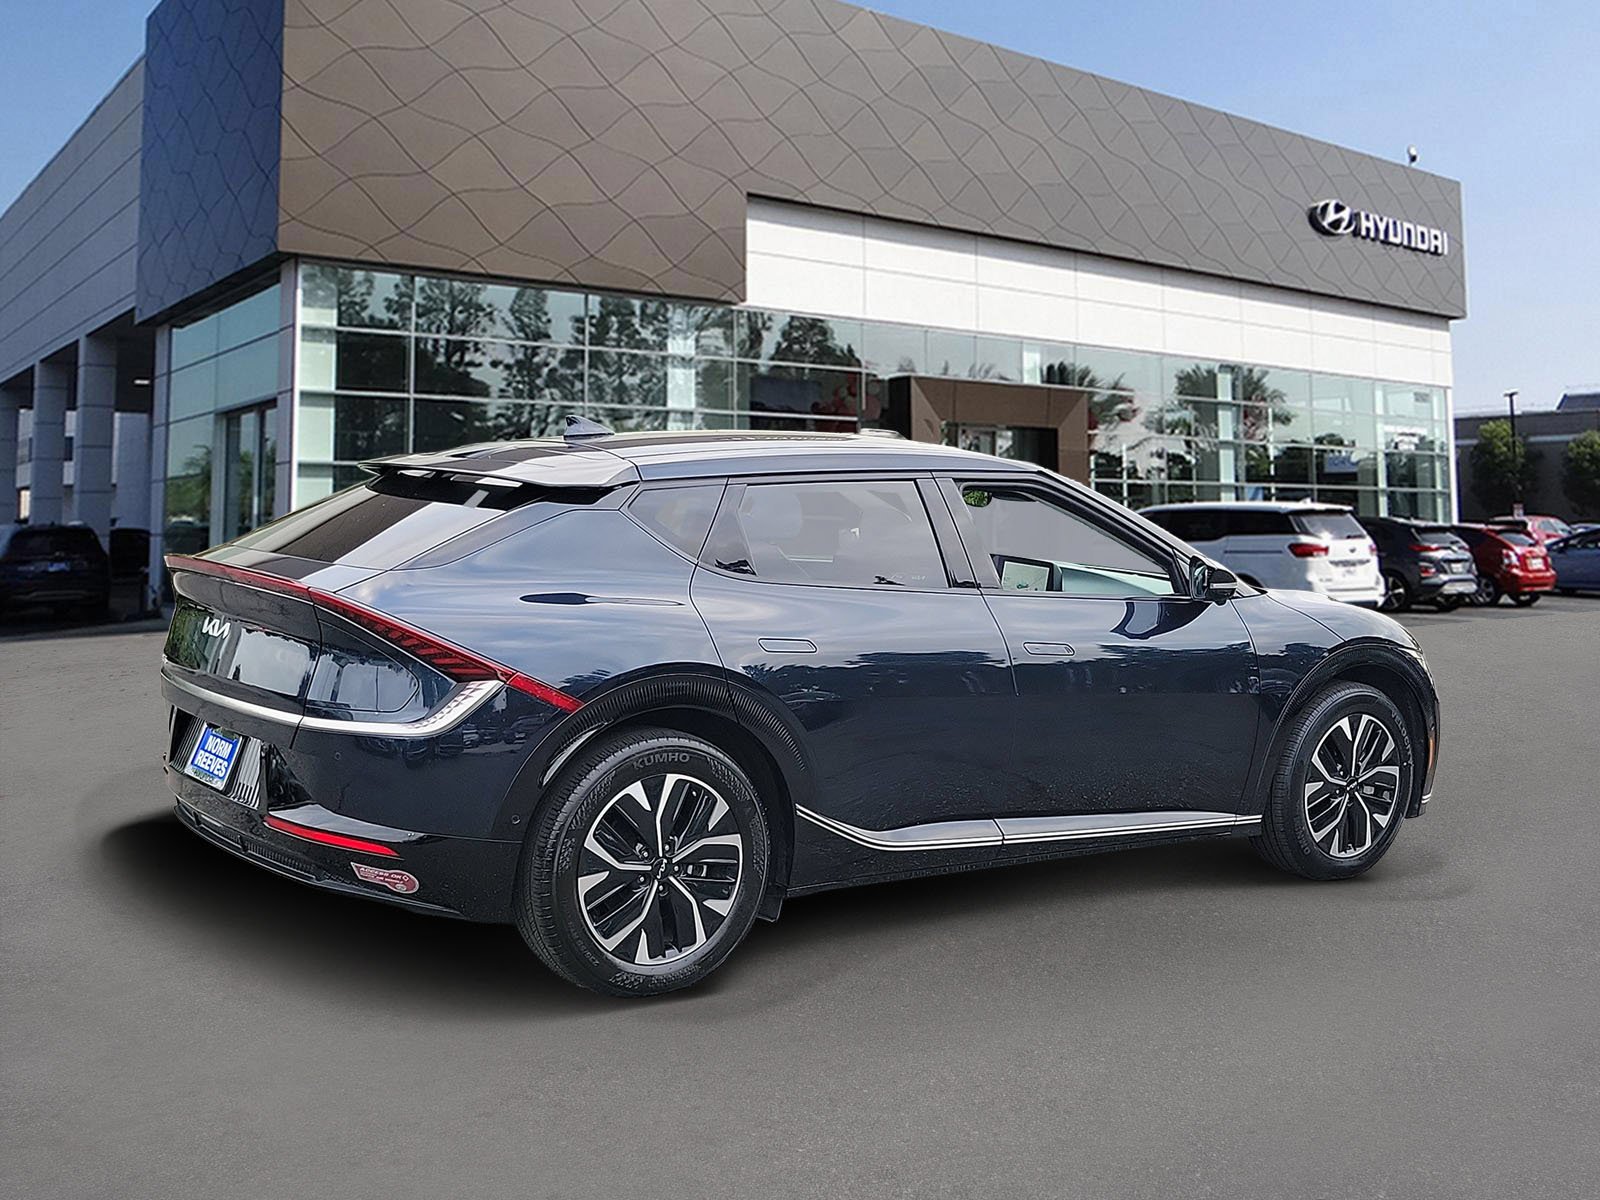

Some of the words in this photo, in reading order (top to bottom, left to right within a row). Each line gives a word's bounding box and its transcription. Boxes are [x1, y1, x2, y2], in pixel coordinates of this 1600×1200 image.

[1360, 211, 1449, 255] HYUNDAI
[204, 734, 233, 759] NORM
[194, 750, 229, 778] REEVES
[632, 752, 690, 770] KUMHO
